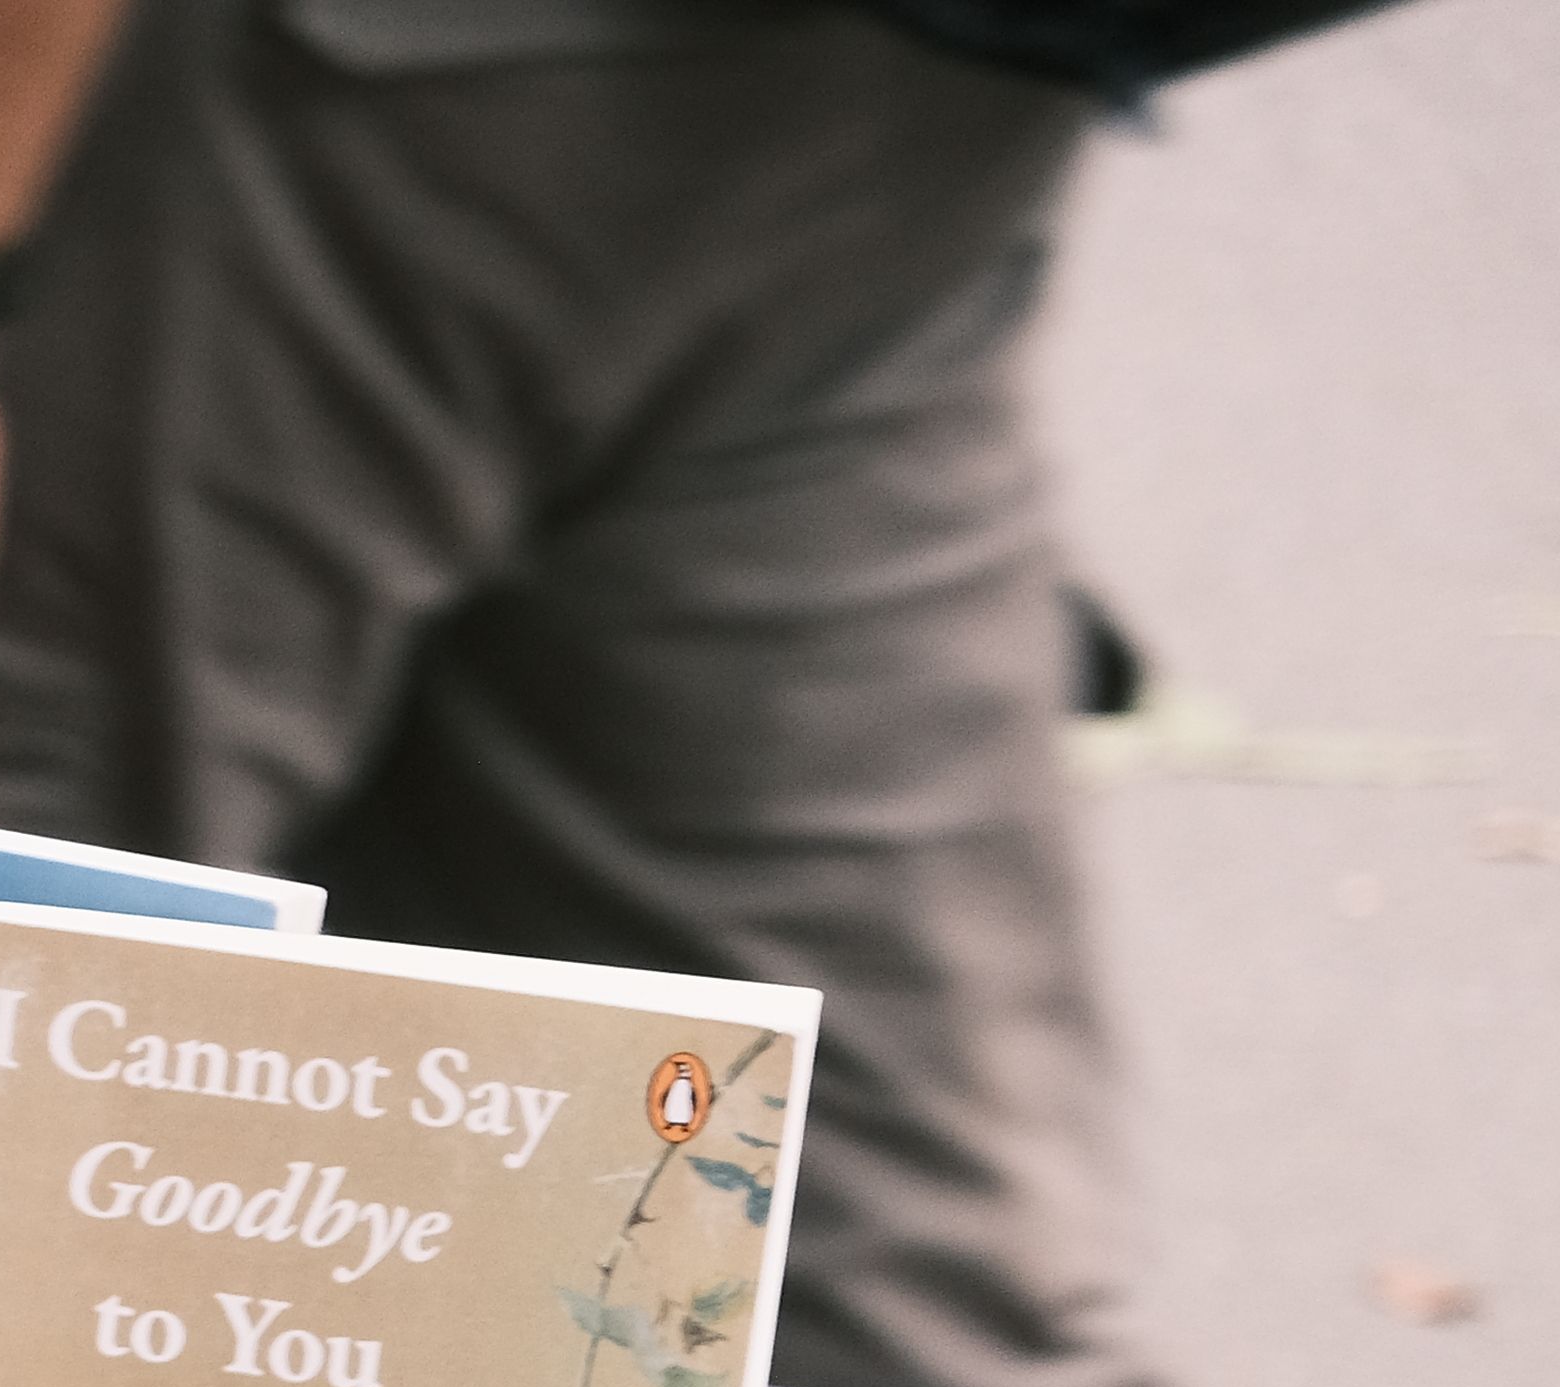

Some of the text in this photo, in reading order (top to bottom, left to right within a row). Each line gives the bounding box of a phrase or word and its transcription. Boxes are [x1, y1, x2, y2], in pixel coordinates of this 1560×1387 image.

[47, 998, 390, 1119] Cannot
[410, 1047, 569, 1170] Say
[68, 1140, 452, 1284] Goodbye
[93, 1294, 187, 1364] to
